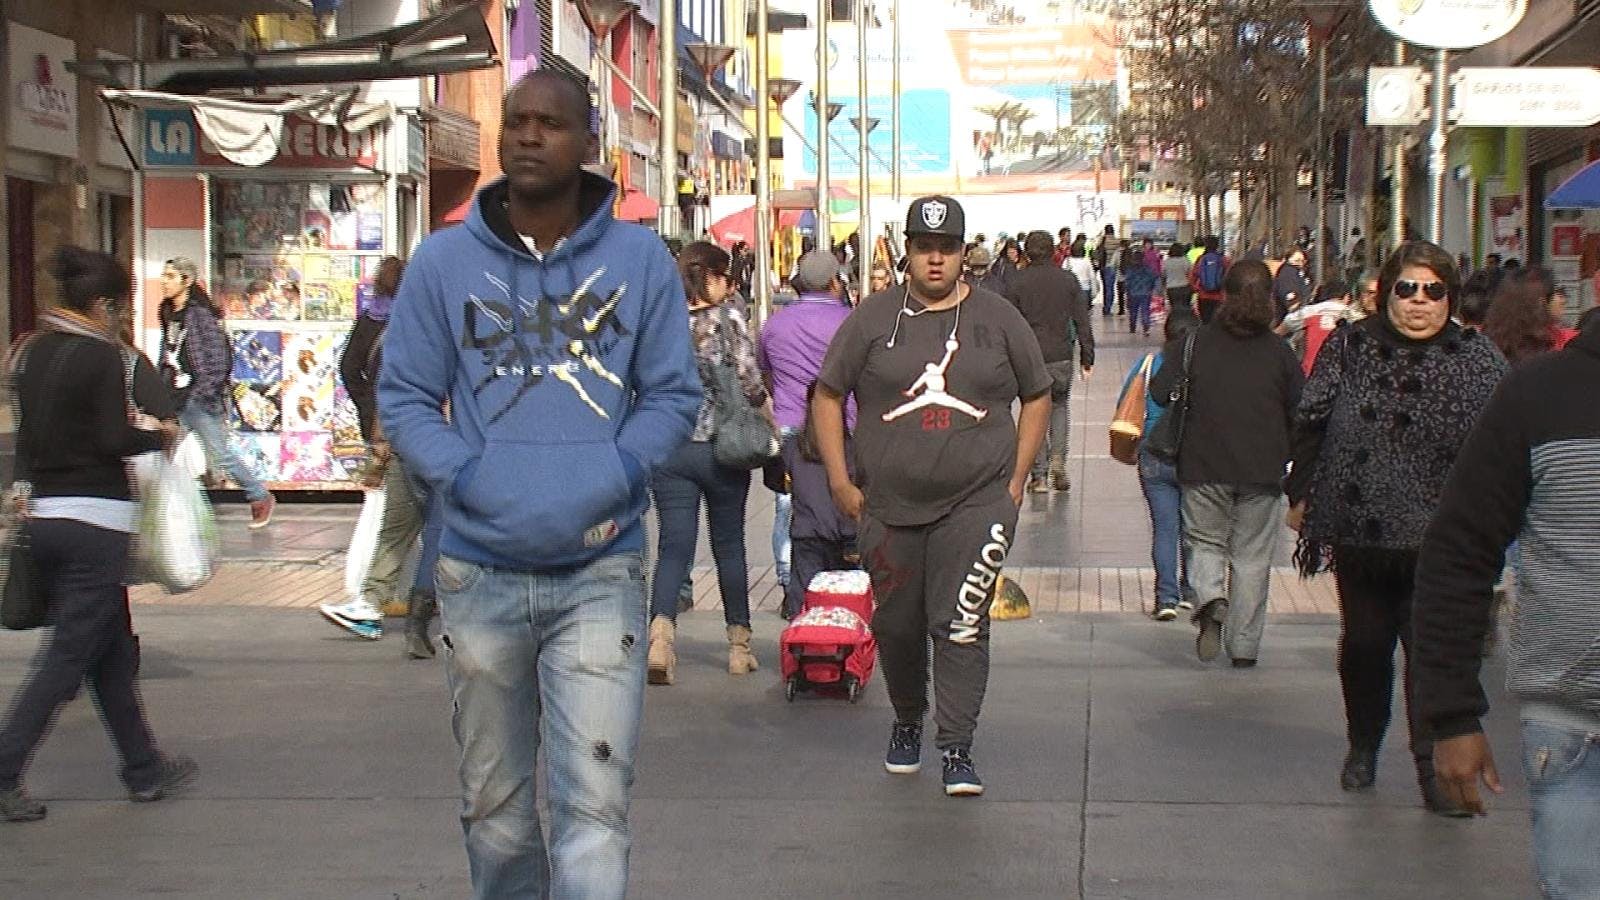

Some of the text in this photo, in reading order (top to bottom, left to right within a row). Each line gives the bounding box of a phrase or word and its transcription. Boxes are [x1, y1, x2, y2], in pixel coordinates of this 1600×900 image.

[148, 118, 192, 154] LA
[921, 408, 951, 431] 23
[948, 522, 1009, 645] JORDAN
